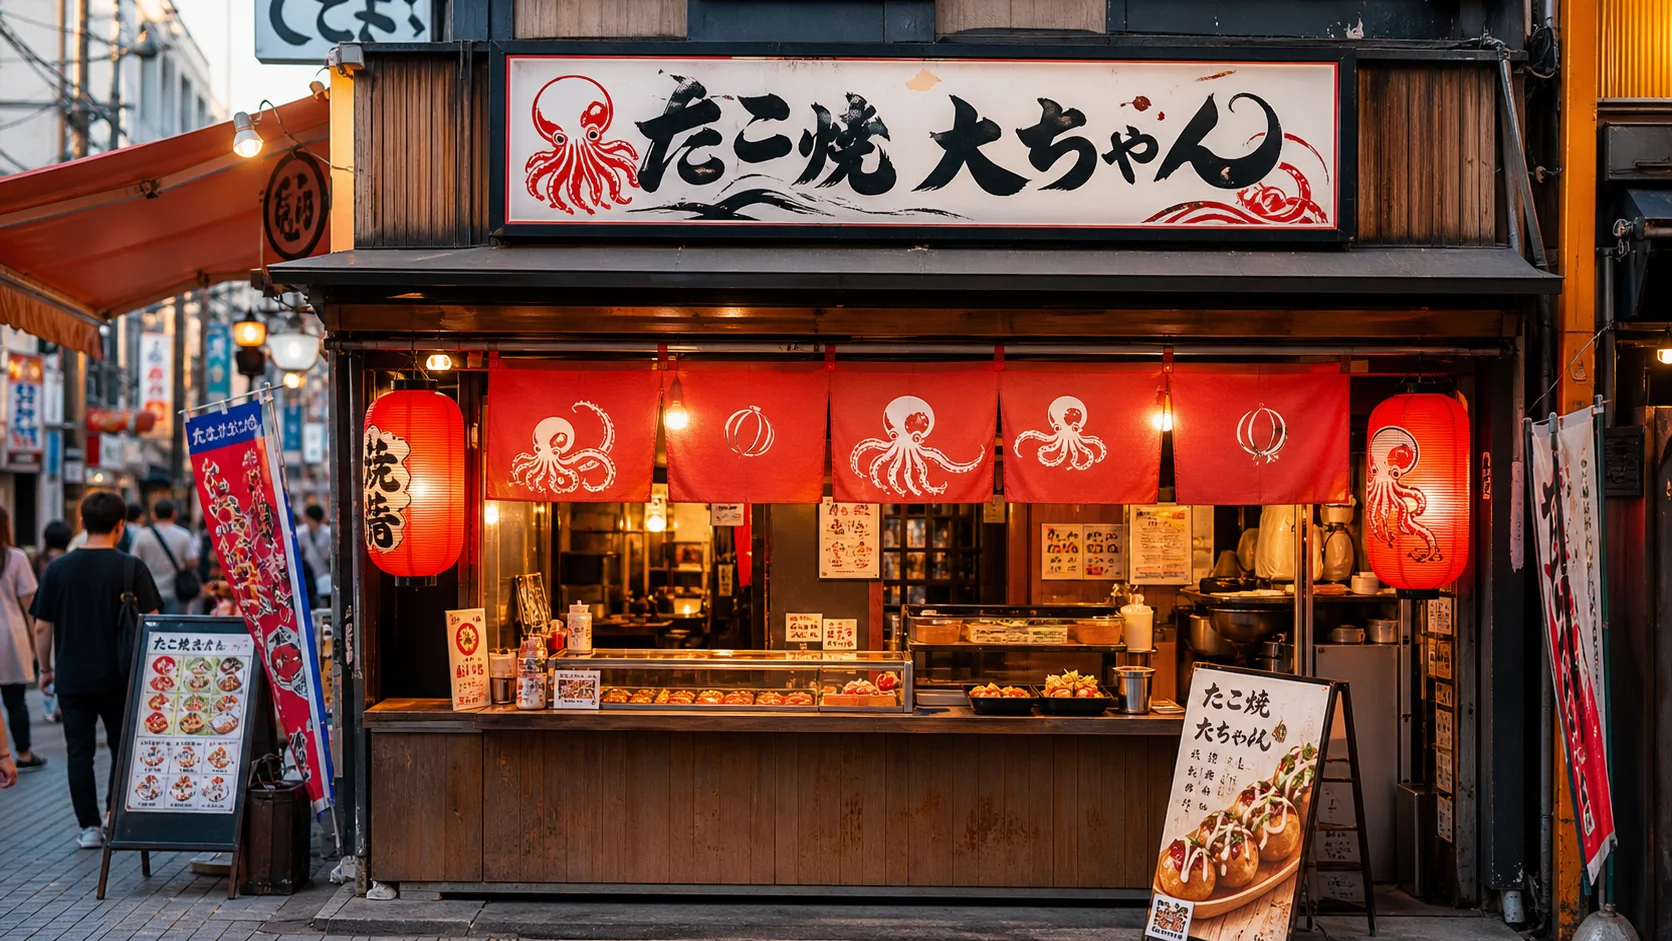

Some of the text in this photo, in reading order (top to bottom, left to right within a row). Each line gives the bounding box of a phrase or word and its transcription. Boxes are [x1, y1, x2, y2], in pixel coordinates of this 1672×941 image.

[636, 72, 1284, 196] たこ焼 大ちゃん
[1202, 682, 1270, 718] たこ焼
